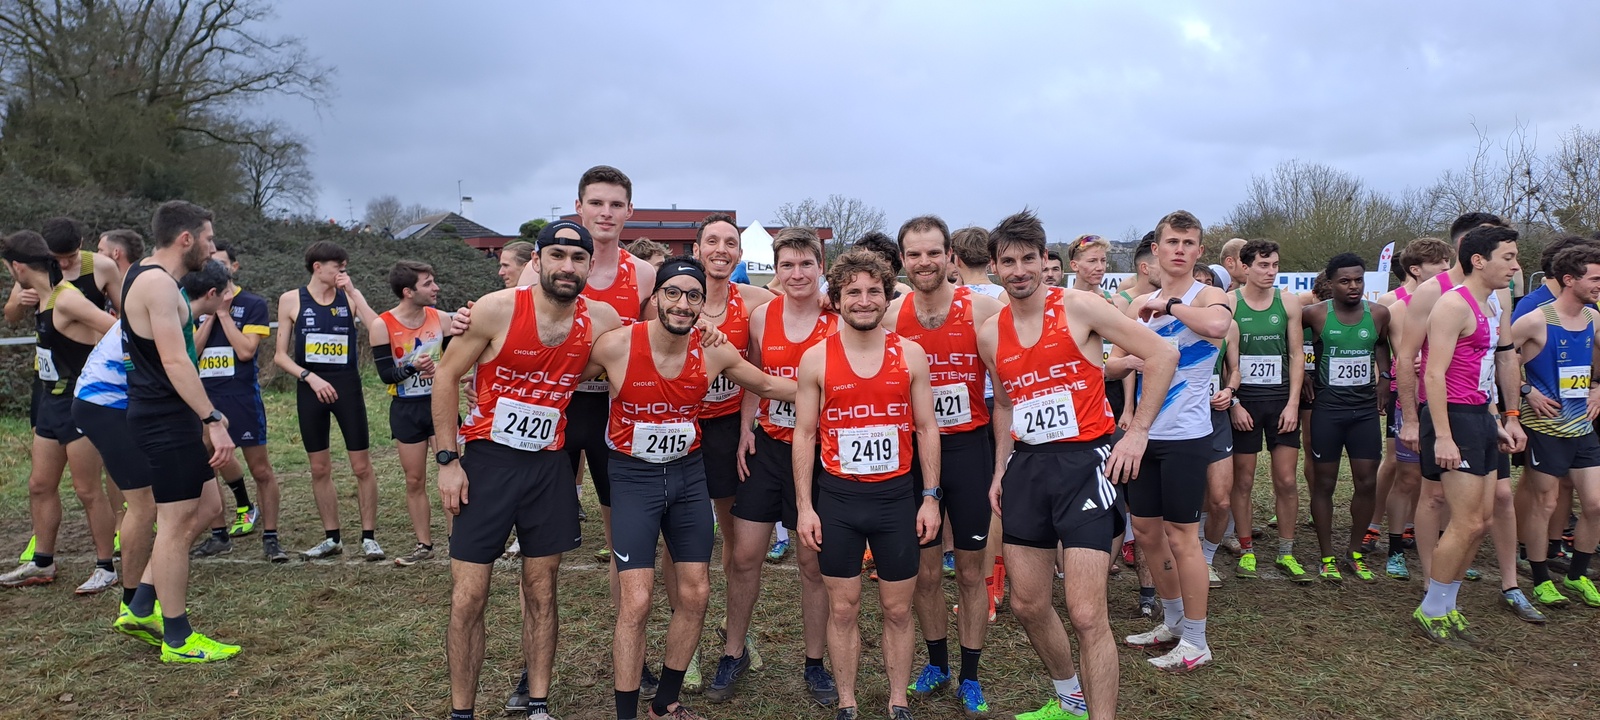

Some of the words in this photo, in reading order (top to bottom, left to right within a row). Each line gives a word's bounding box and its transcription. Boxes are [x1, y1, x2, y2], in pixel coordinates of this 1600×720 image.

[314, 342, 343, 356] 2633
[202, 355, 229, 370] 2638
[1250, 363, 1275, 377] 2371
[1338, 363, 1367, 379] 2369
[1002, 360, 1081, 393] CHOLET
[826, 403, 908, 421] CHOLET
[934, 395, 961, 416] 421
[503, 412, 552, 440] 2420
[1024, 404, 1069, 434] 2425
[646, 434, 687, 453] 2415
[1046, 430, 1064, 440] FABIEN
[519, 441, 543, 450] ANTONIN
[851, 437, 892, 462] 2419
[870, 464, 889, 472] MARTIN
